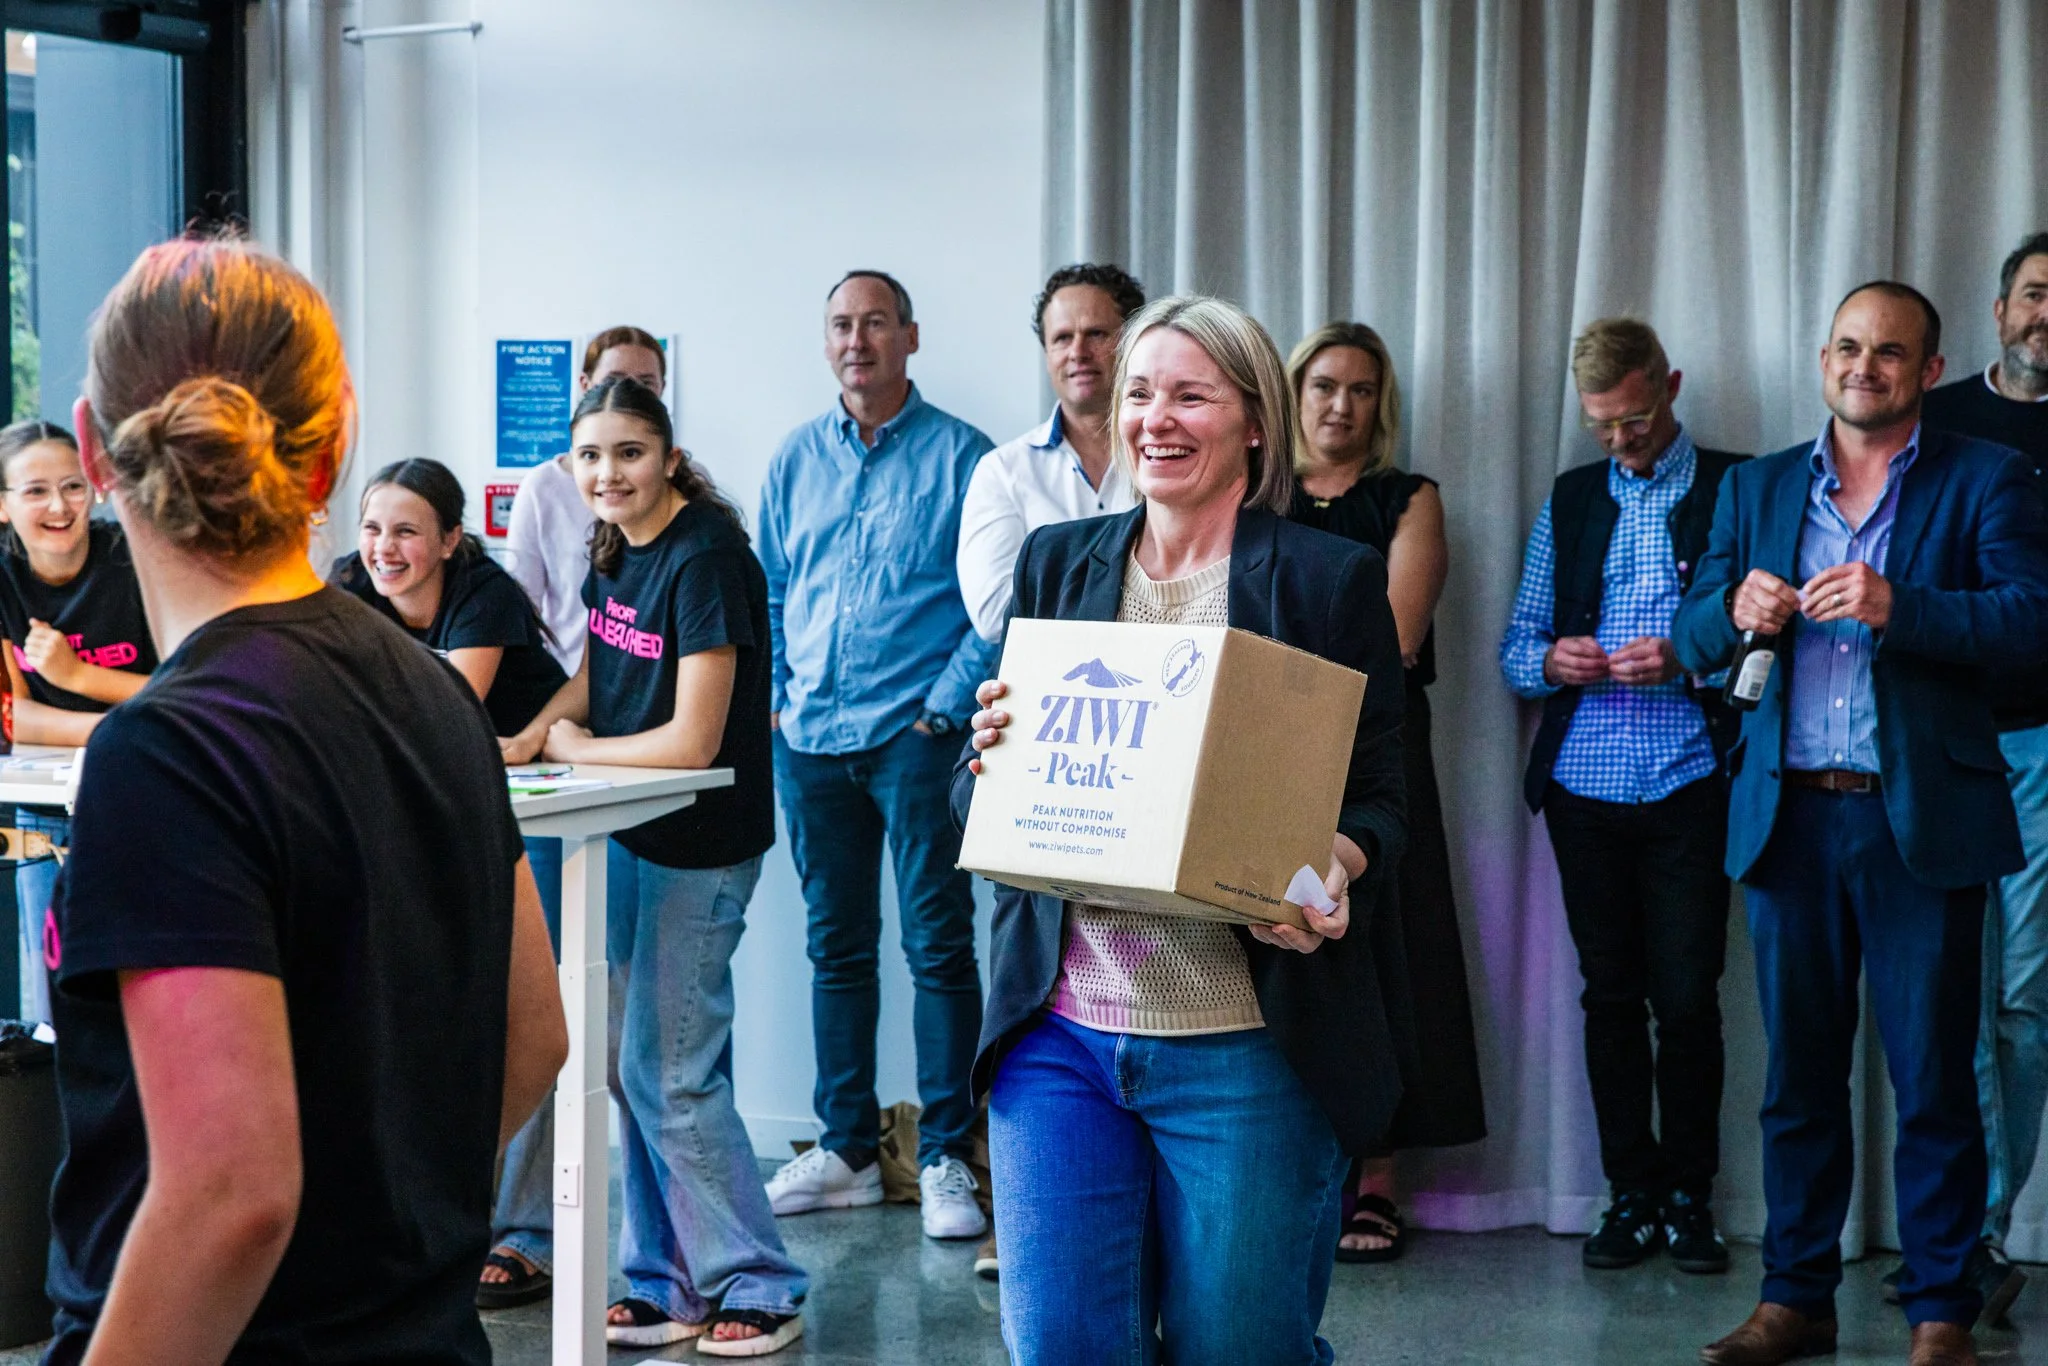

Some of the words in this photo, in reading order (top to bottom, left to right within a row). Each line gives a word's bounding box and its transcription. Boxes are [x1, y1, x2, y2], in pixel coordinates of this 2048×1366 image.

[501, 344, 525, 354] FIRE
[527, 344, 566, 354] ACTION
[515, 356, 553, 366] NOTICE
[1034, 695, 1152, 749] ZIWI
[1032, 804, 1058, 817] PEAK
[1059, 807, 1113, 821] NUTRITION
[1015, 818, 1060, 832] WITHOUT
[1061, 823, 1127, 839] COMPROMISE
[1029, 840, 1104, 856] www.ziwipets.com
[1215, 881, 1237, 894] Product
[1244, 890, 1258, 899] New
[1258, 893, 1281, 906] Zealand
